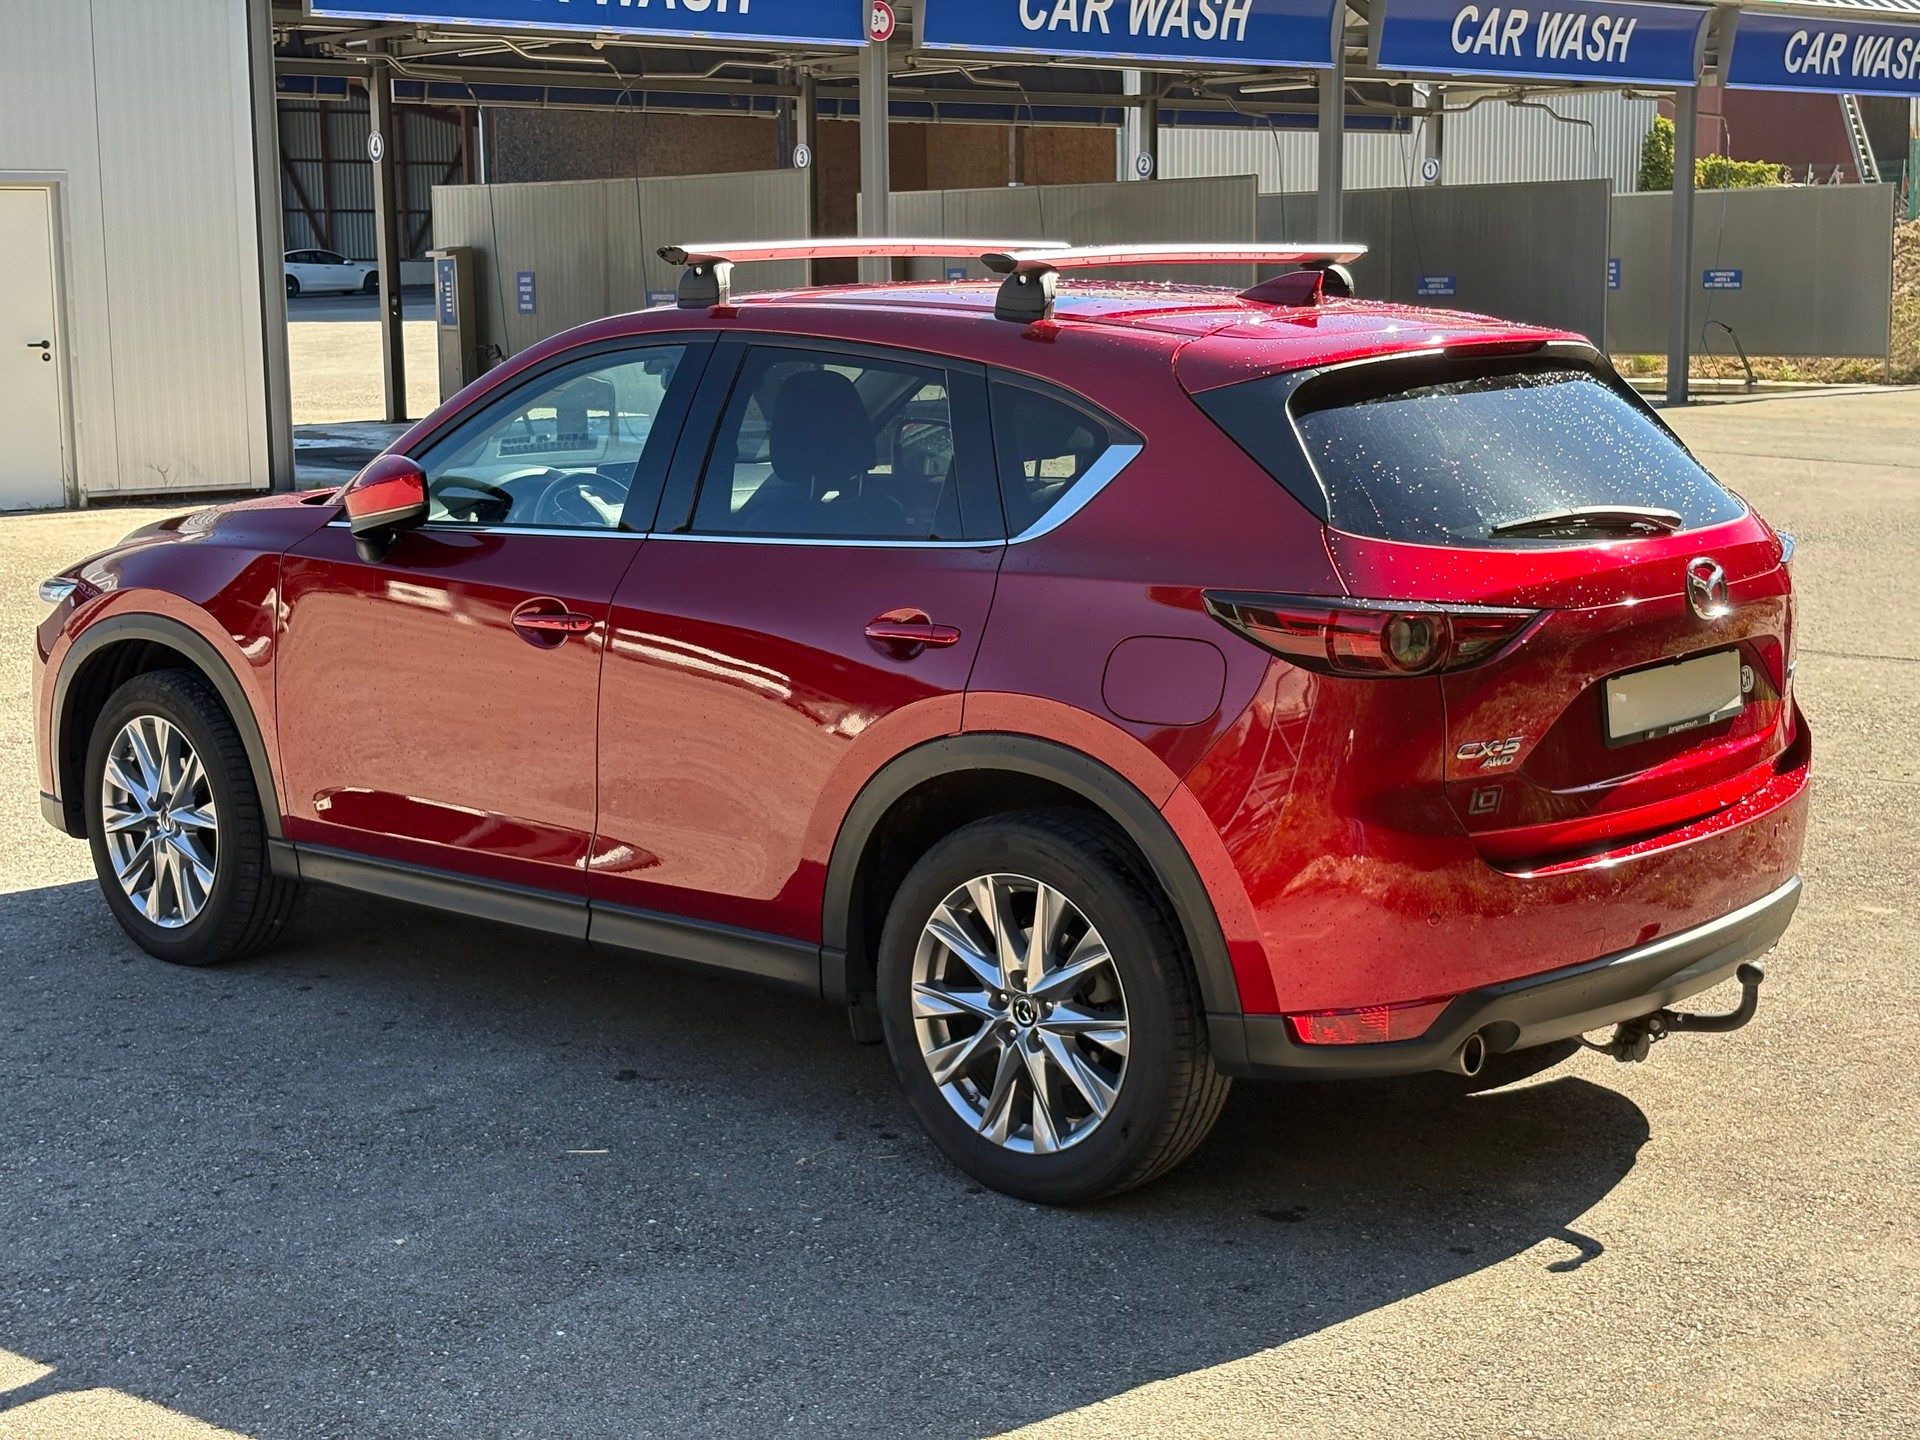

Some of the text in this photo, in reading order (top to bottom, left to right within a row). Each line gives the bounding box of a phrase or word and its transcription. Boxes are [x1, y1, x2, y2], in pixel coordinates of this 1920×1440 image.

[873, 14, 879, 25] 3
[1019, 0, 1252, 42] CAR WASH
[1451, 4, 1638, 63] CAR WASH
[1784, 29, 1848, 76] CAR
[373, 138, 379, 154] 4
[799, 150, 805, 165] 3
[1140, 157, 1147, 171] 2
[1426, 163, 1432, 176] 1
[1741, 670, 1751, 688] CH
[1456, 736, 1524, 760] CX-5
[1480, 755, 1515, 768] AWD
